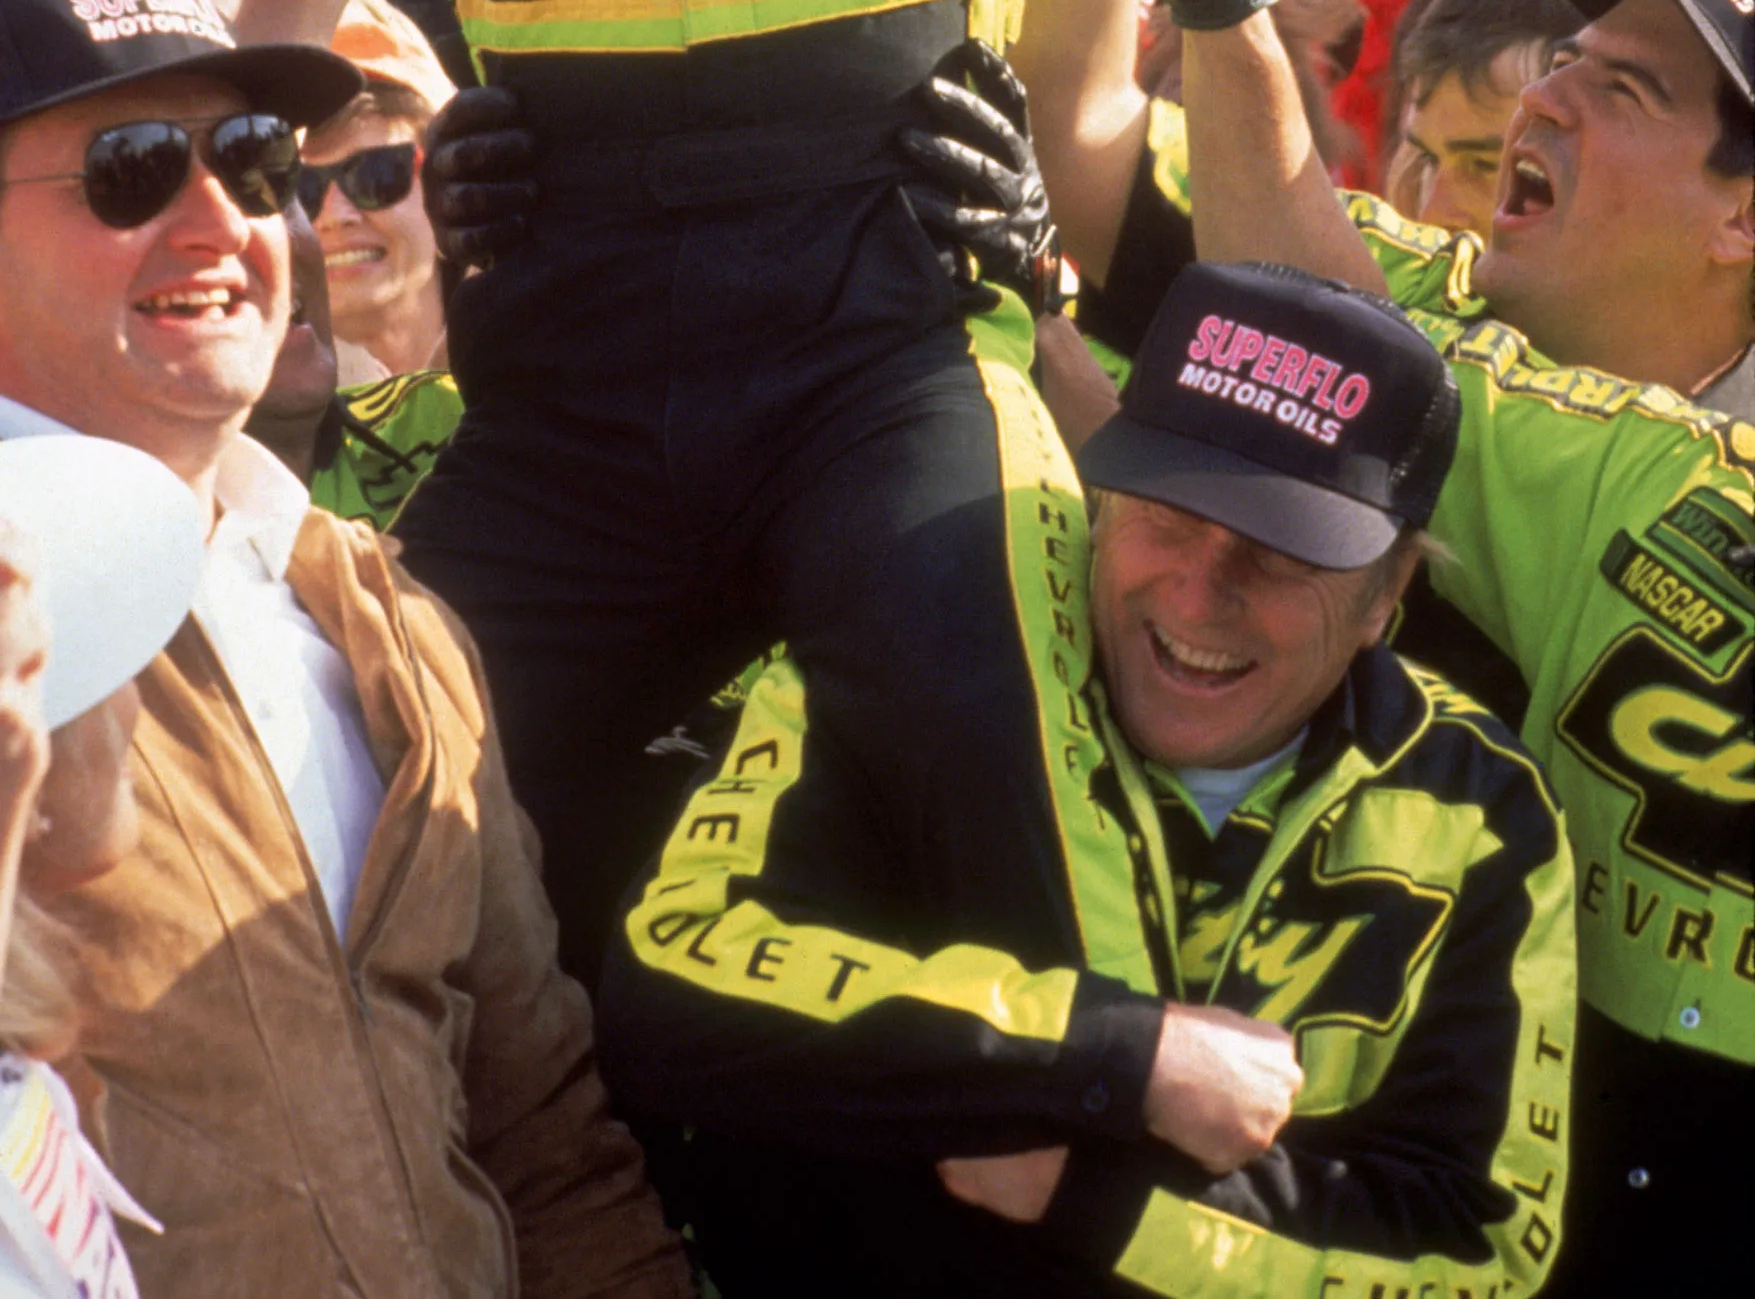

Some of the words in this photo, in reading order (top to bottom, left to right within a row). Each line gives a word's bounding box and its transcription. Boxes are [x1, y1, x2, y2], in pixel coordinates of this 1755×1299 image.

[1178, 363, 1272, 414] MOTOR
[1275, 396, 1344, 446] OILS
[1188, 315, 1370, 419] SUPERFLO
[1619, 552, 1726, 643] NASCAR
